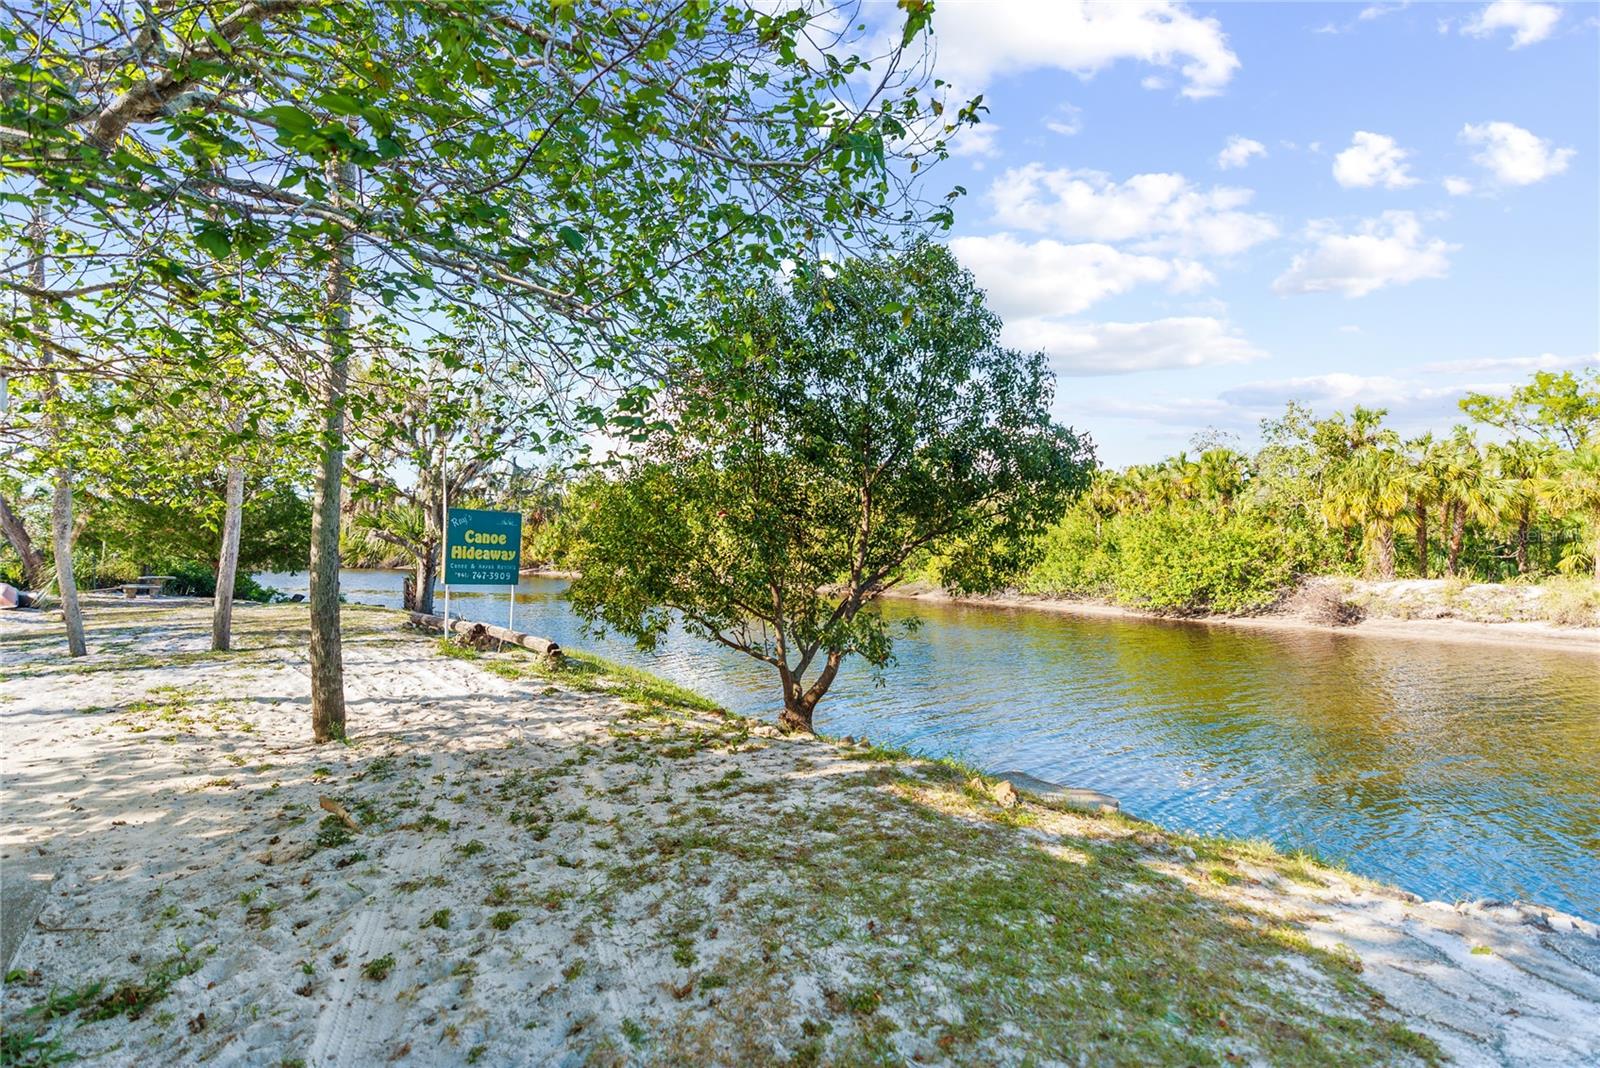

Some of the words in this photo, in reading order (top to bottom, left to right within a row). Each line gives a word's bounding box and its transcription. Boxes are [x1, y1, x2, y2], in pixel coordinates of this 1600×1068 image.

[451, 514, 472, 528] Ray's
[464, 529, 507, 545] Canoe
[451, 545, 516, 561] Hideaway
[473, 571, 511, 580] 747-3909
